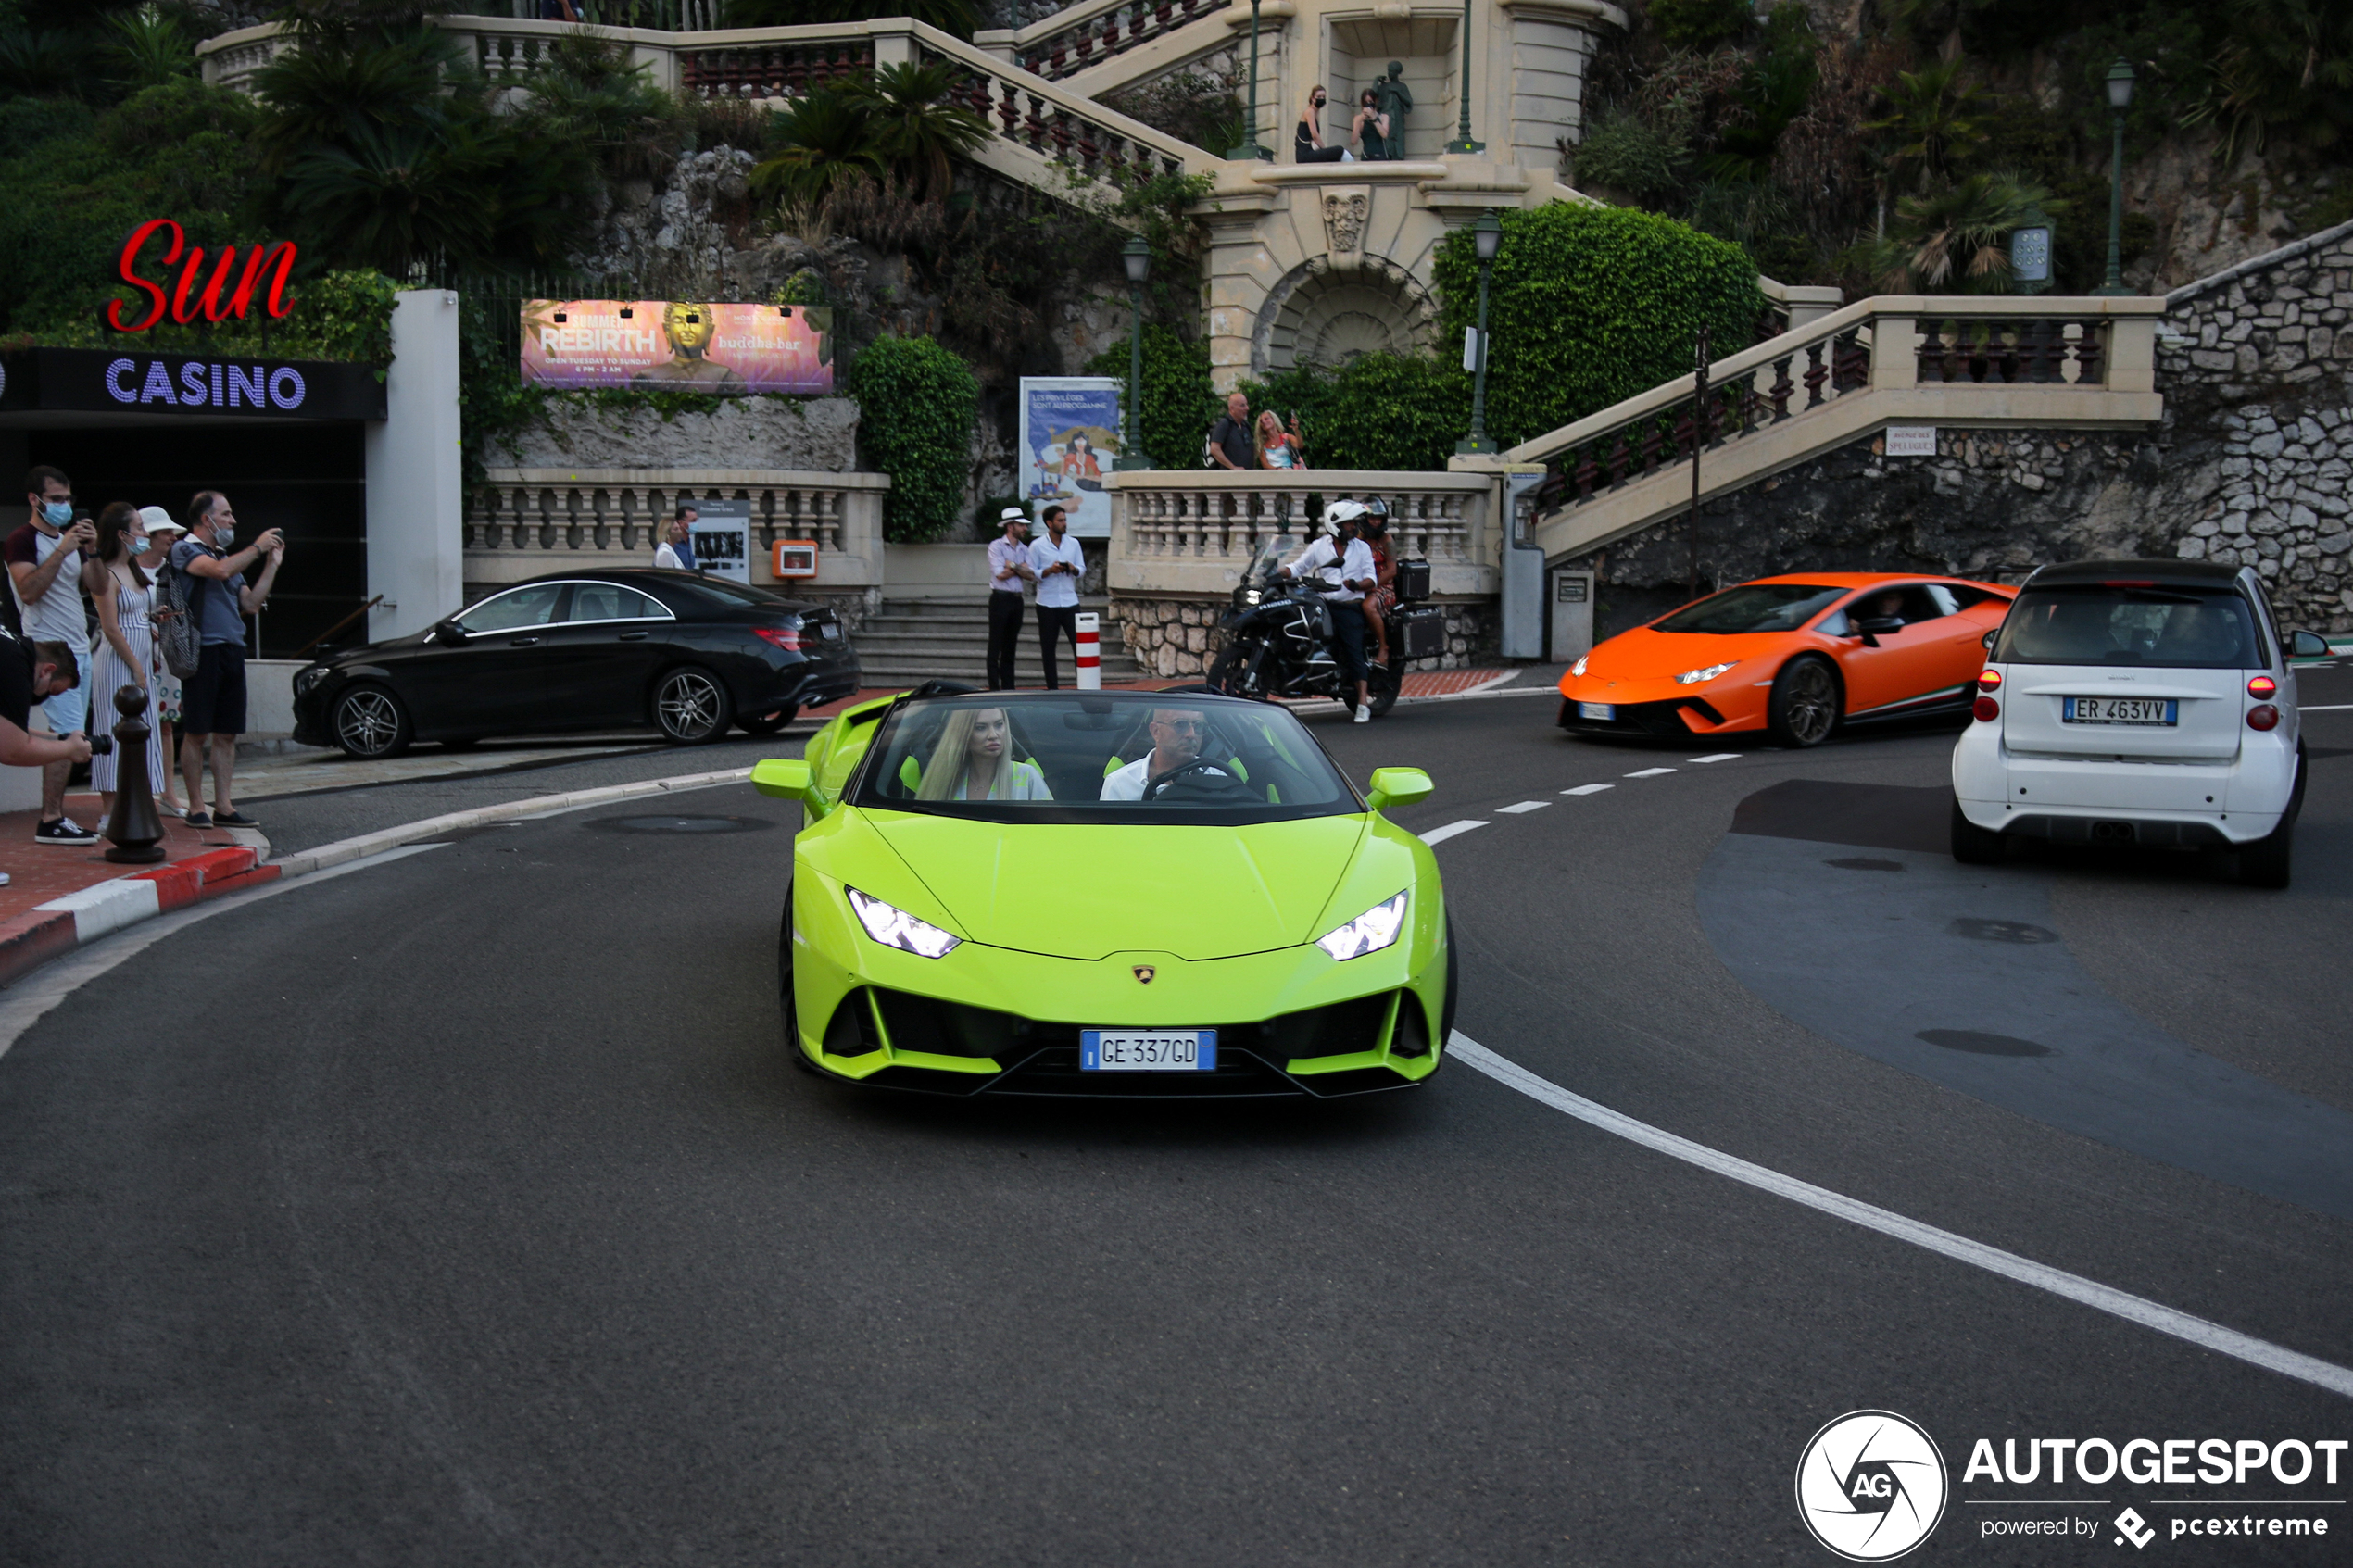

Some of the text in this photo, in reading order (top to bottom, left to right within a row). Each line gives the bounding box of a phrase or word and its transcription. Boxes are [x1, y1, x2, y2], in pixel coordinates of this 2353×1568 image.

[107, 219, 297, 332] Sun
[572, 315, 624, 329] SUMMER
[540, 328, 656, 352] REBIRTH
[718, 335, 800, 350] buddha-bar
[106, 358, 307, 410] CASINO
[1046, 393, 1085, 402] PRIVILÈGES
[1258, 598, 1292, 610] R1200
[2077, 699, 2099, 718] ER
[2107, 700, 2164, 720] 463VV
[1102, 1039, 1126, 1063] GE
[1133, 1039, 1196, 1063] 337GD
